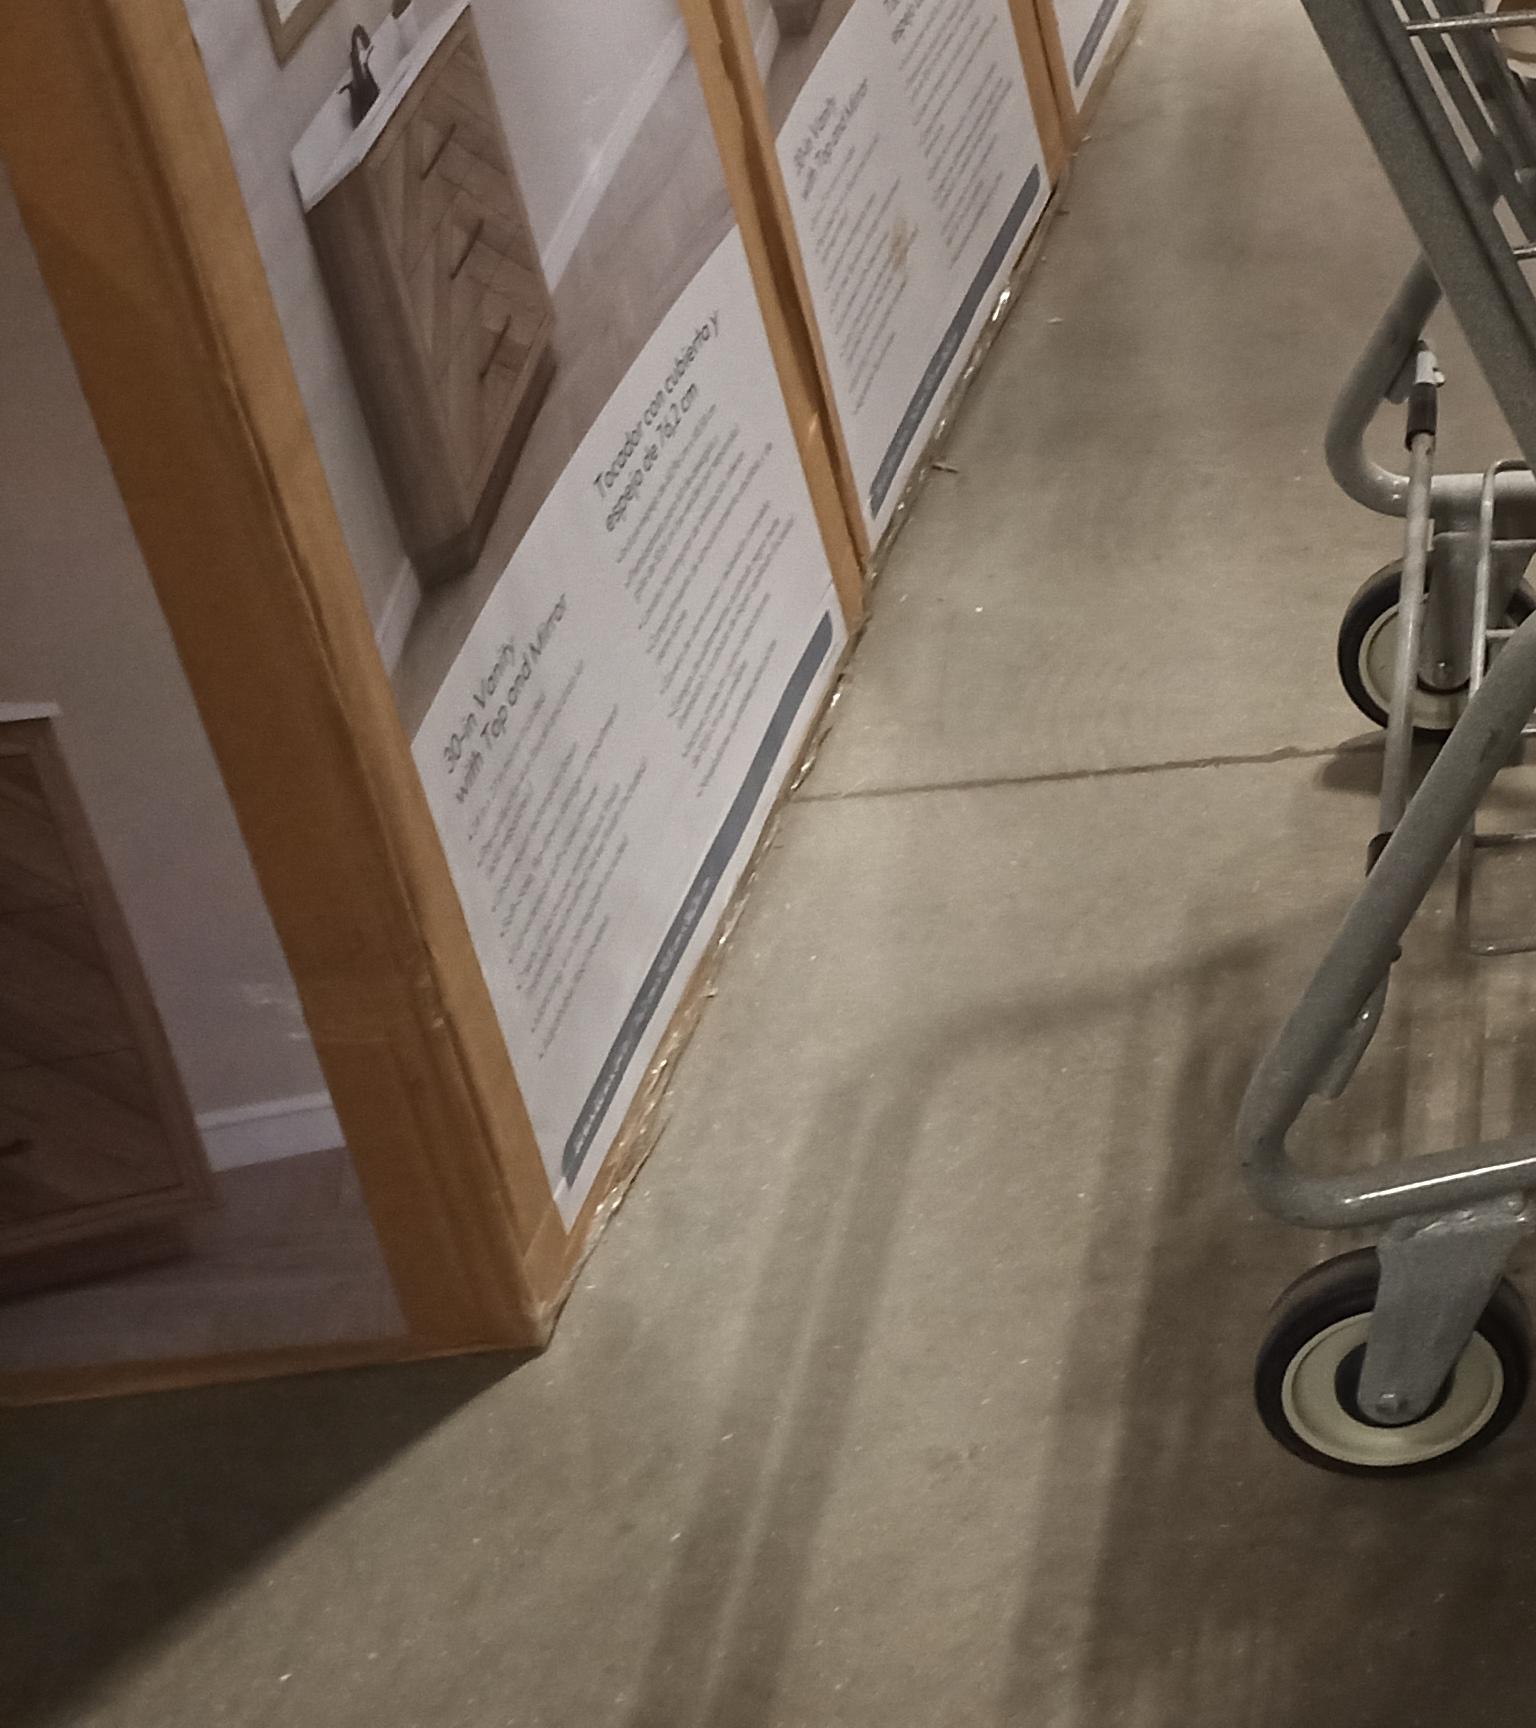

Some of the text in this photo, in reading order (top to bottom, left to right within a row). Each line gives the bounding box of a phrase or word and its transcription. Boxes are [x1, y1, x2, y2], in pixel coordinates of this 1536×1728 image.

[593, 309, 719, 498] Tocador con cubierta y
[606, 468, 644, 533] espejo
[643, 443, 658, 472] de
[681, 383, 698, 413] cm
[444, 635, 515, 774] 30-in Vanity
[456, 593, 567, 804] with Top and Mirror
